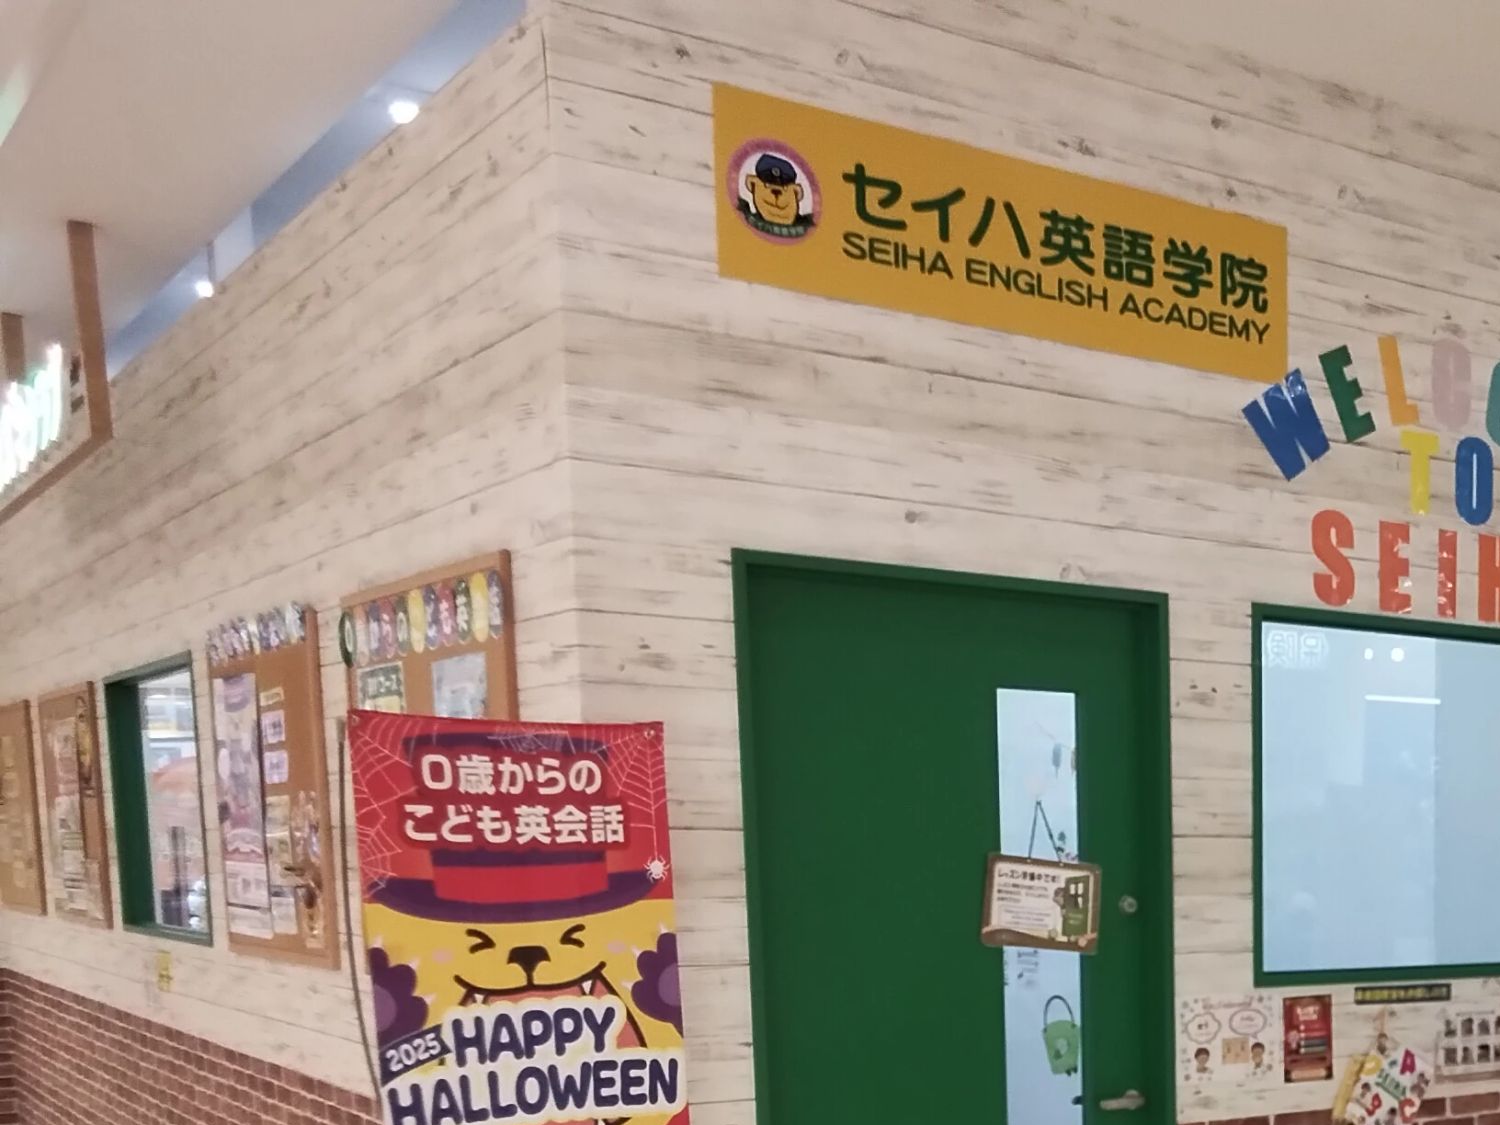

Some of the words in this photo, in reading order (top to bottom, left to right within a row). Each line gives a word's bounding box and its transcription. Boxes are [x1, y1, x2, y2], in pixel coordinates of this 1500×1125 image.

[842, 163, 1269, 314] セイハ英語学院
[842, 231, 953, 280] SEIHA
[965, 259, 1109, 312] ENGLISH
[1118, 293, 1271, 344] ACADEMY
[1401, 429, 1493, 526] TO
[421, 754, 602, 795] 0歳からの
[403, 803, 625, 845] こども英会話
[385, 1032, 442, 1072] 2025
[452, 1006, 616, 1068] HAPPY
